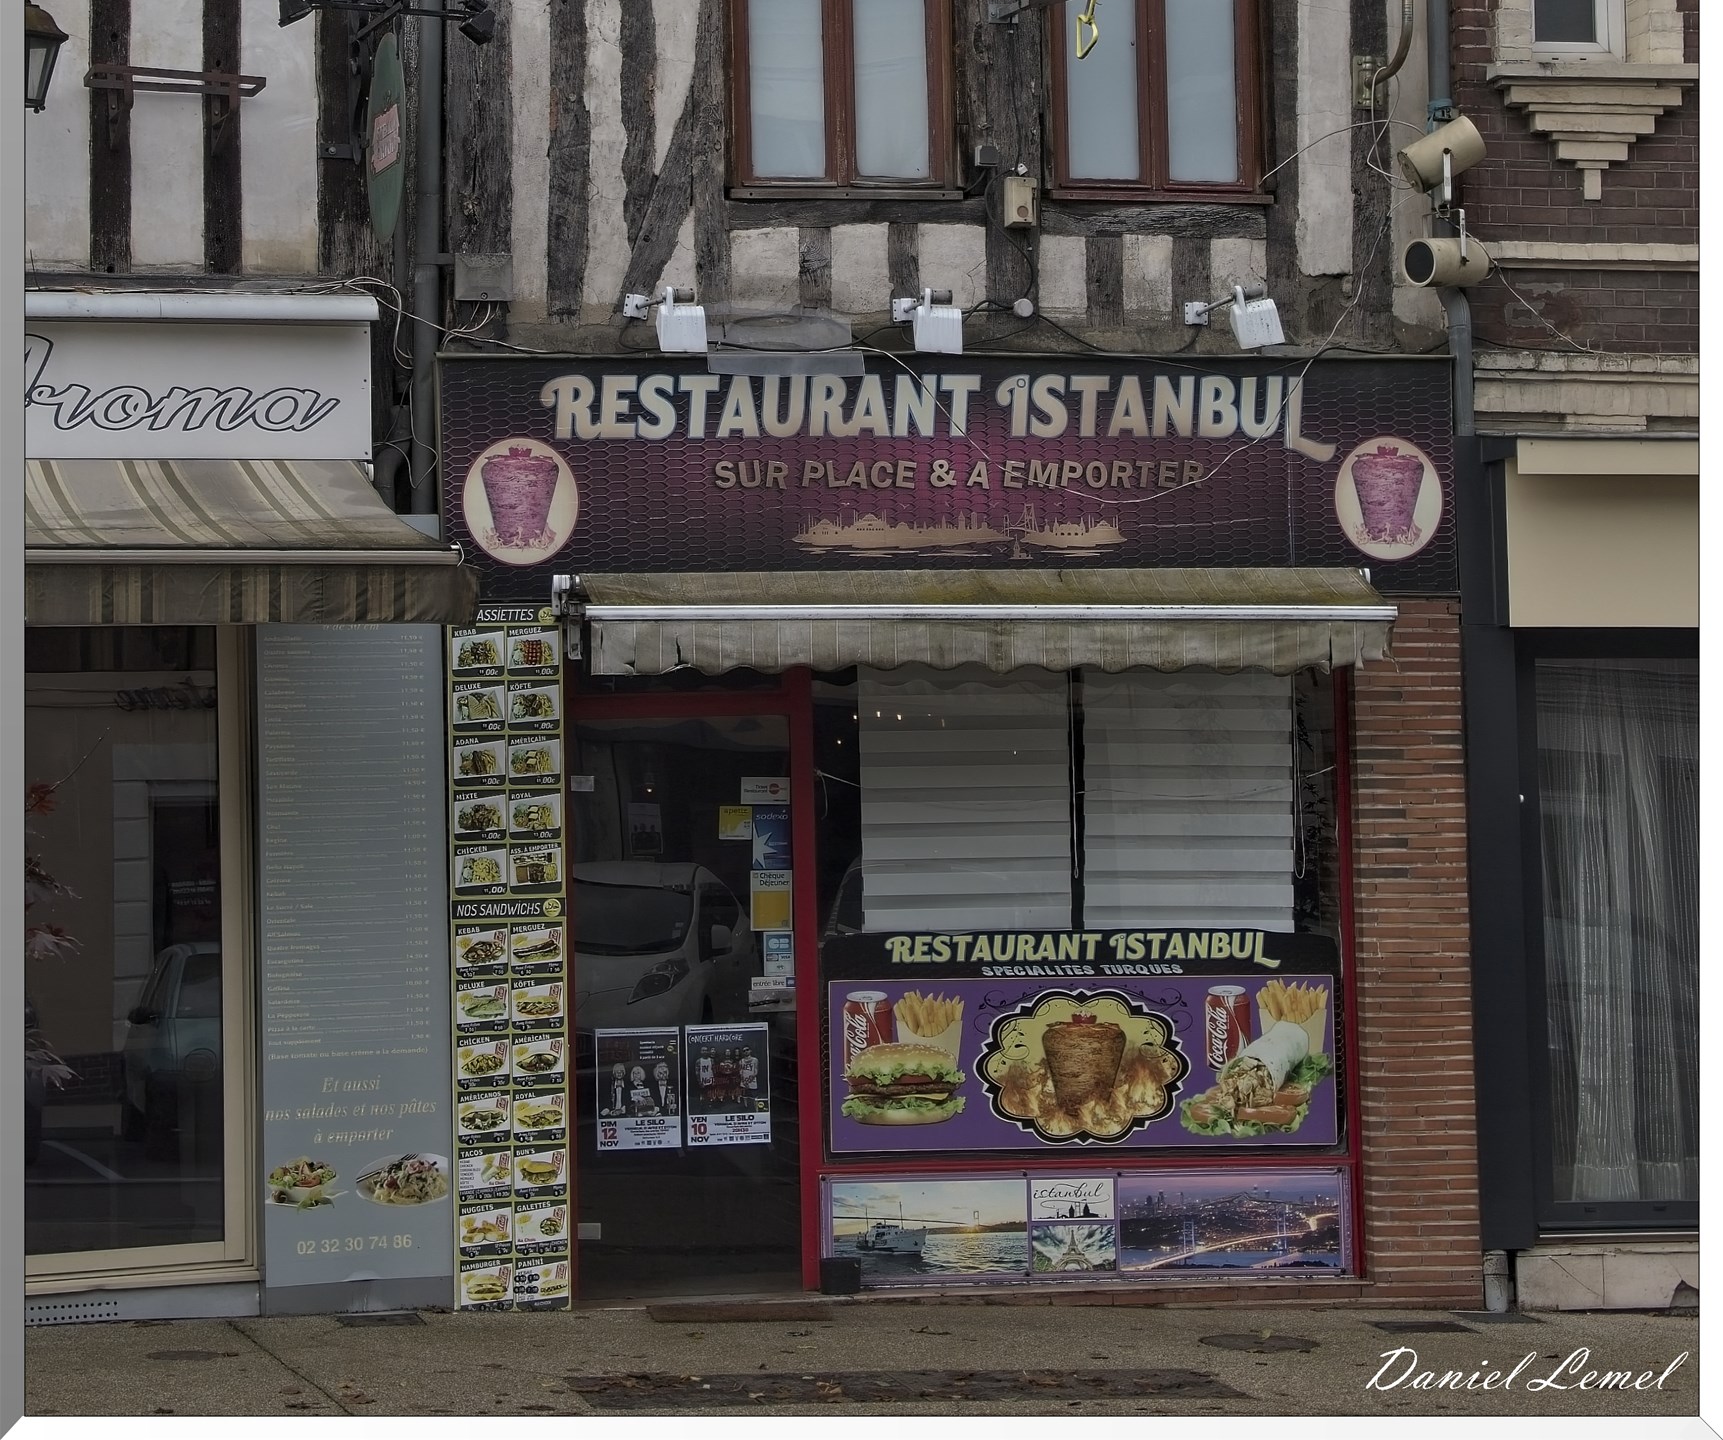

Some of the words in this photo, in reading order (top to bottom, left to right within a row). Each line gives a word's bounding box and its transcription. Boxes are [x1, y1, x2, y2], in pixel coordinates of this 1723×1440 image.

[541, 373, 981, 440] RESTAURANT
[715, 460, 788, 490] SUR
[801, 460, 916, 490] PLACE
[930, 460, 957, 489] &
[967, 461, 990, 490] A
[1004, 459, 1205, 490] EMPORTER
[454, 629, 477, 637] KEBAB
[509, 627, 542, 636] MERGUEZ
[455, 683, 481, 691] DELUXE
[455, 737, 479, 746] ADANA
[511, 792, 532, 800] ROYAL
[456, 904, 478, 917] NOS
[458, 926, 480, 935] KEBAB
[513, 923, 545, 933] MERGUEZ
[885, 934, 1098, 964] RESTAURANT
[981, 965, 1095, 976] SPECIALITES
[1099, 964, 1184, 975] TURQUES
[458, 981, 485, 991] DELUXE
[321, 1077, 338, 1093] Et
[343, 1074, 381, 1092] aussi
[515, 1092, 536, 1100] ROYAL
[264, 1108, 290, 1122] nos
[295, 1102, 348, 1120] salades
[352, 1104, 365, 1117] et
[369, 1104, 396, 1116] nos
[398, 1098, 437, 1119] pâtes
[646, 1118, 666, 1126] SILO
[736, 1114, 755, 1122] SILO
[600, 1120, 617, 1128] DIM
[601, 1128, 618, 1140] 12
[691, 1123, 708, 1136] 10
[313, 1128, 323, 1144] à
[327, 1127, 394, 1146] emporter
[600, 1140, 619, 1148] NOV
[460, 1149, 483, 1158] TACOS
[1033, 1182, 1104, 1199] istanbul
[461, 1204, 494, 1214] NUGGETS
[517, 1201, 551, 1211] GALETTES
[297, 1241, 316, 1255] 02
[321, 1239, 340, 1253] 32
[344, 1237, 364, 1252] 30
[369, 1236, 388, 1250] 74
[393, 1234, 412, 1248] 86
[461, 1259, 501, 1271] HAMBURGER
